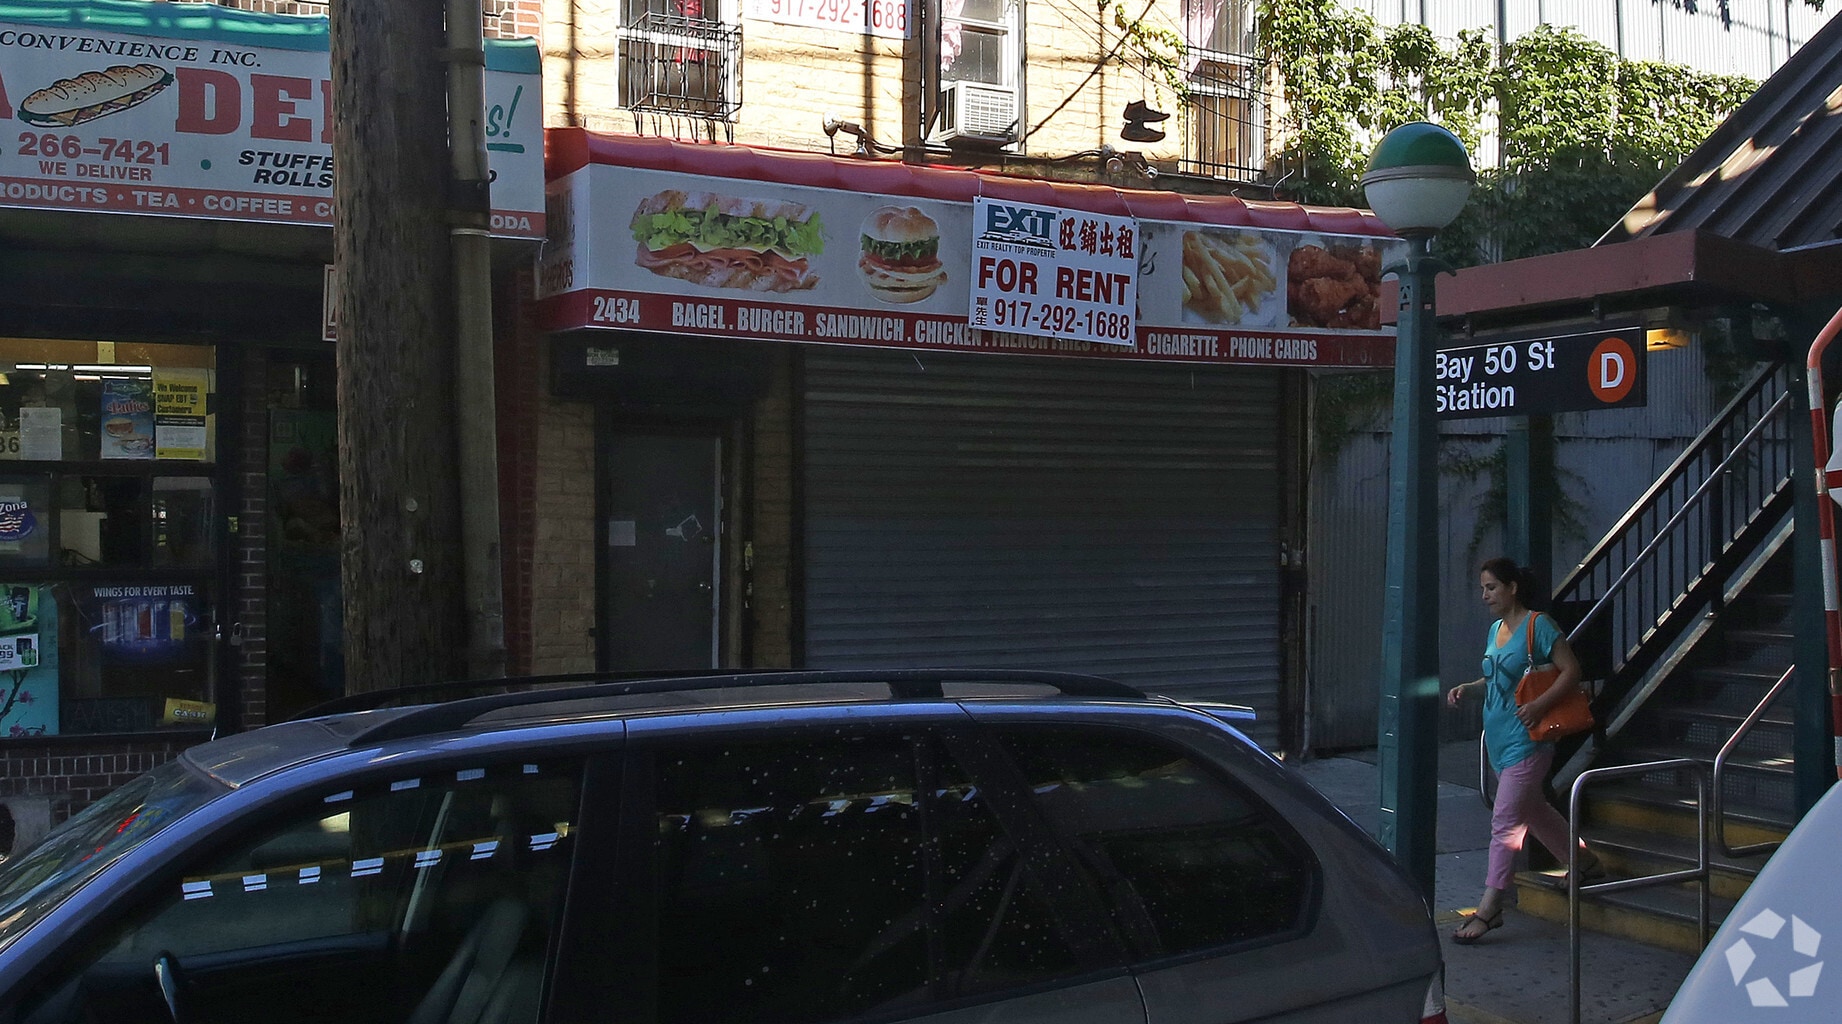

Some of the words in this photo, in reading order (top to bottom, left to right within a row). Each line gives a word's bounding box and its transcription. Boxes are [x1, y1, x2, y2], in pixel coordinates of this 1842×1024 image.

[0, 30, 199, 62] CONVENIENCE
[209, 49, 261, 68] INC.
[175, 66, 333, 144] DE
[18, 131, 169, 166] 266-7421
[238, 150, 334, 171] STUFFE
[39, 160, 67, 176] WE
[76, 163, 153, 181] DELIVER
[253, 168, 333, 188] ROLLS
[0, 182, 107, 204] ODUCTS
[132, 189, 180, 208] TEA
[203, 194, 293, 215] COFFEE
[490, 214, 532, 231] ODA
[976, 240, 989, 250] EXIT
[991, 243, 1012, 253] REALTY
[1014, 245, 1025, 255] TOP
[978, 256, 1038, 295] FOR
[1055, 266, 1131, 306] RENT
[593, 296, 640, 323] 2434
[672, 301, 726, 330] BAGEL
[737, 307, 804, 335] BURGER
[816, 312, 905, 341] SANDWICH
[914, 319, 982, 347] CHICKEN
[1147, 333, 1219, 357] CIGARETTE
[1230, 336, 1272, 360] PHONE
[1274, 338, 1317, 361] CARDS
[994, 298, 1130, 340] 917-292-1688
[1436, 353, 1475, 384] Bay
[1484, 345, 1518, 376] 50
[1527, 341, 1555, 372] St
[1600, 352, 1626, 389] D
[1436, 382, 1515, 413] Station
[94, 587, 123, 597] WINGS
[124, 586, 141, 596] FOR
[143, 586, 167, 596] EVERY
[170, 585, 194, 596] TASTE.
